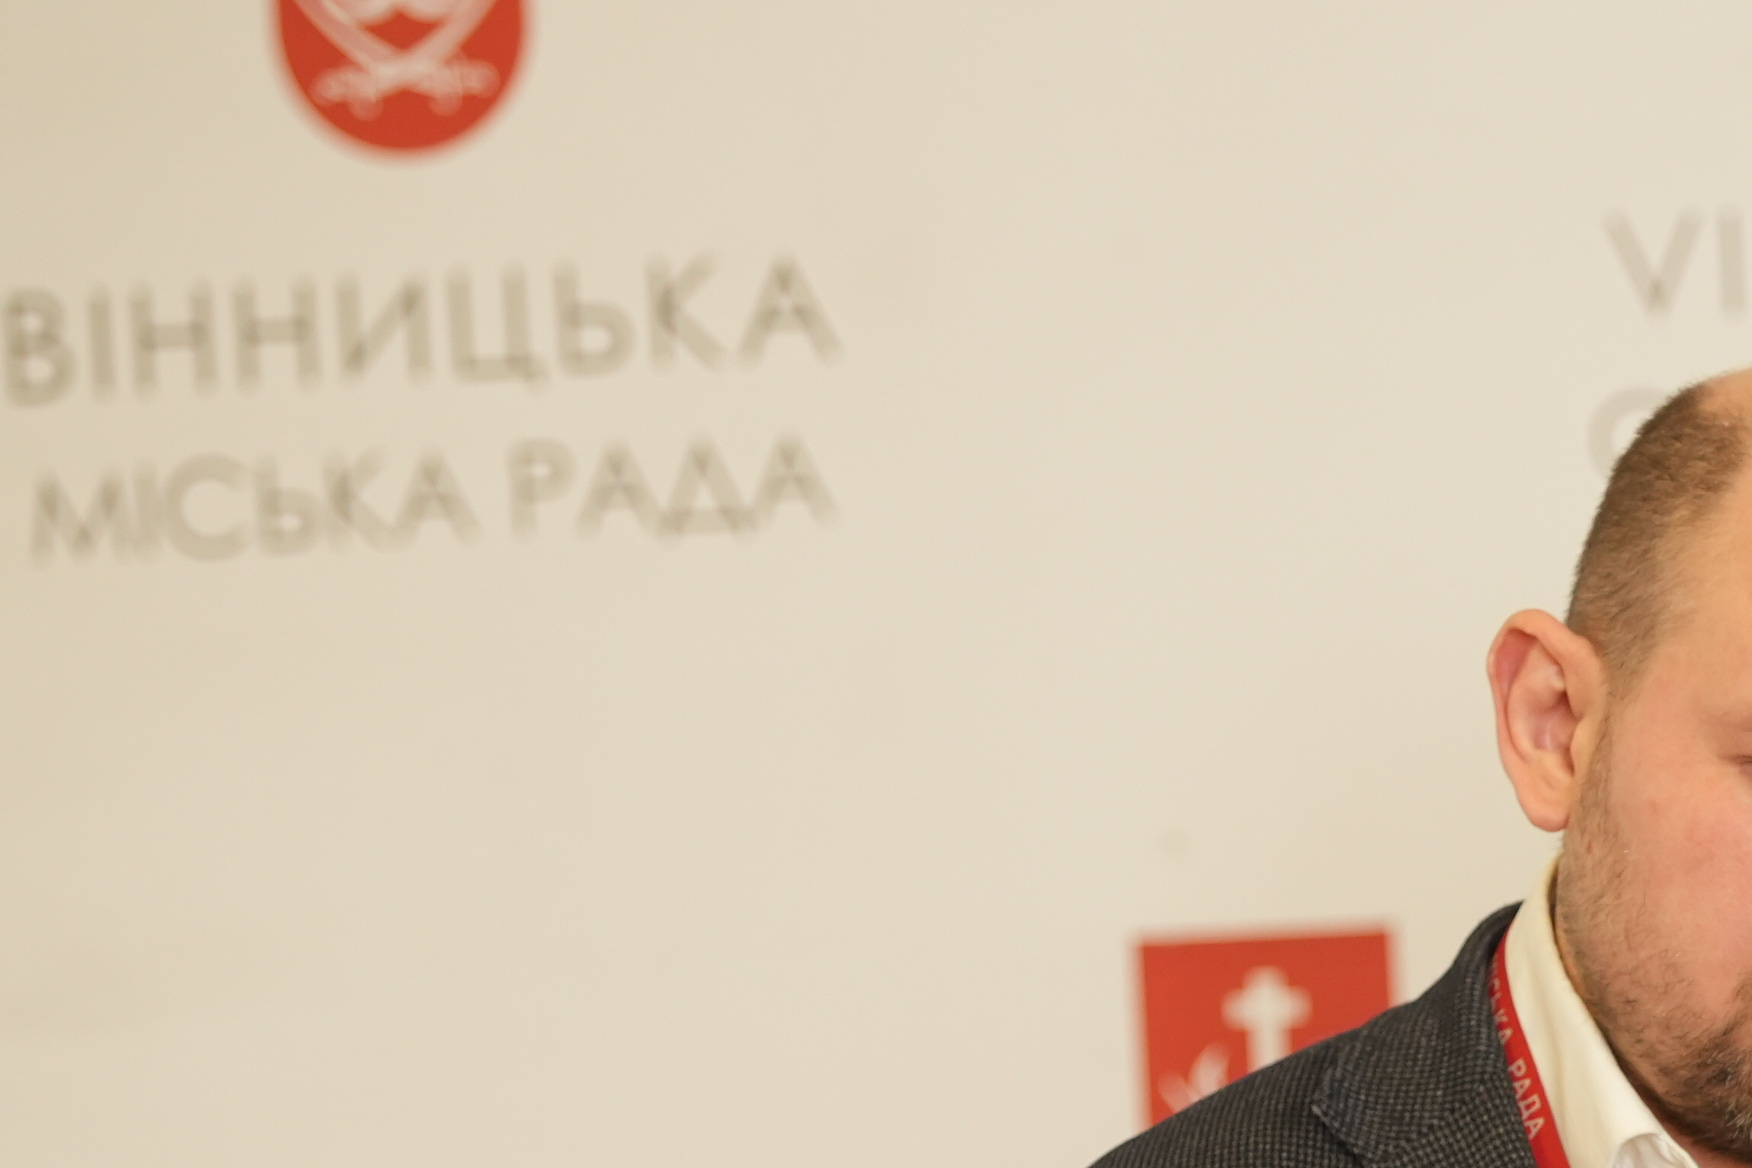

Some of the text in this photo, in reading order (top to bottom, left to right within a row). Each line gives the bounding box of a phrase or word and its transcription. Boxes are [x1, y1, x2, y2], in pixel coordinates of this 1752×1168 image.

[2, 250, 842, 406] ВІННИЦЬКА
[30, 430, 840, 568] МІСЬКА РАДА
[1508, 1058, 1545, 1140] РАДА
